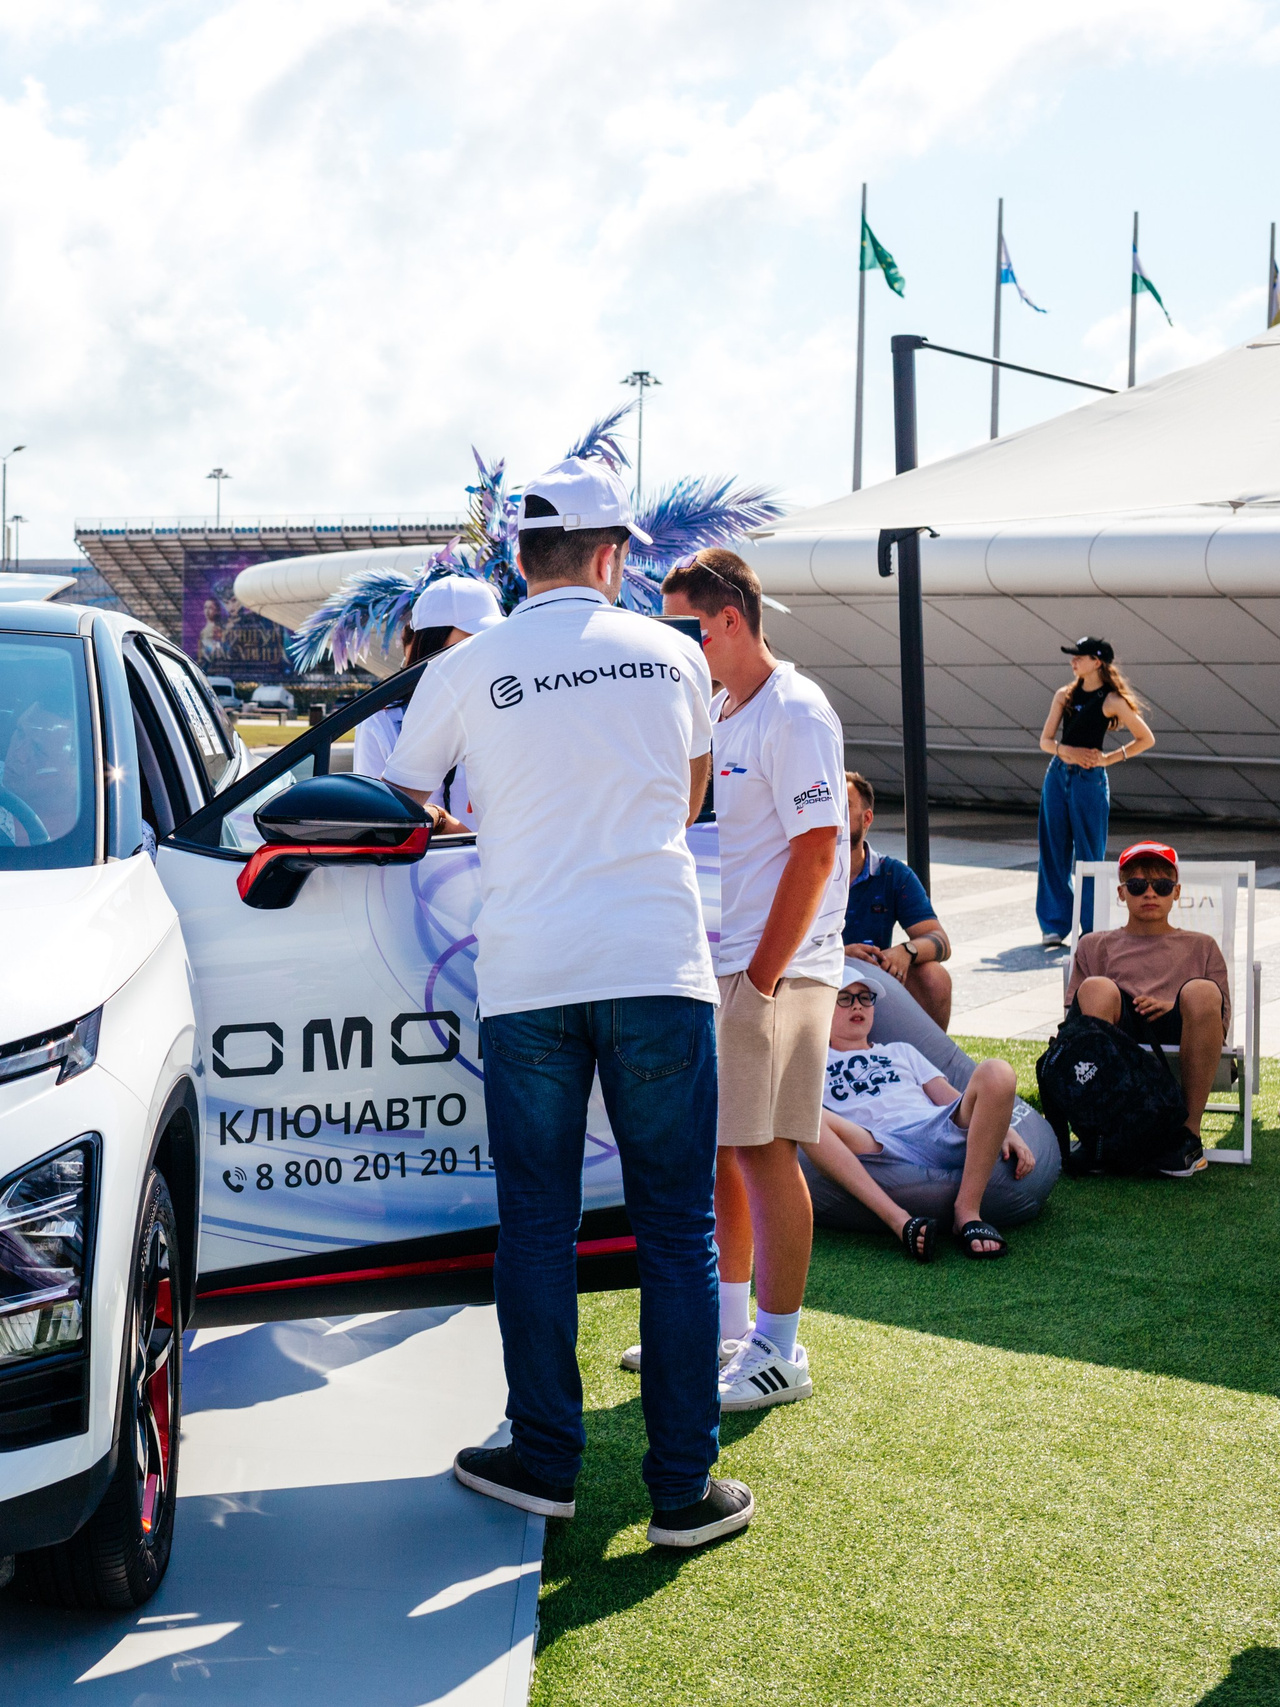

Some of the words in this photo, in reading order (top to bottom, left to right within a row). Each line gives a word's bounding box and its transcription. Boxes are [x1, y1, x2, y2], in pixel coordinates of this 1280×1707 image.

[212, 1010, 483, 1078] OMO
[220, 1093, 467, 1145] КЛЮЧАВТО
[255, 1163, 275, 1191] 8
[284, 1157, 343, 1188] 800
[353, 1151, 406, 1182] 201
[420, 1146, 458, 1176] 20
[752, 1338, 771, 1354] adidas
